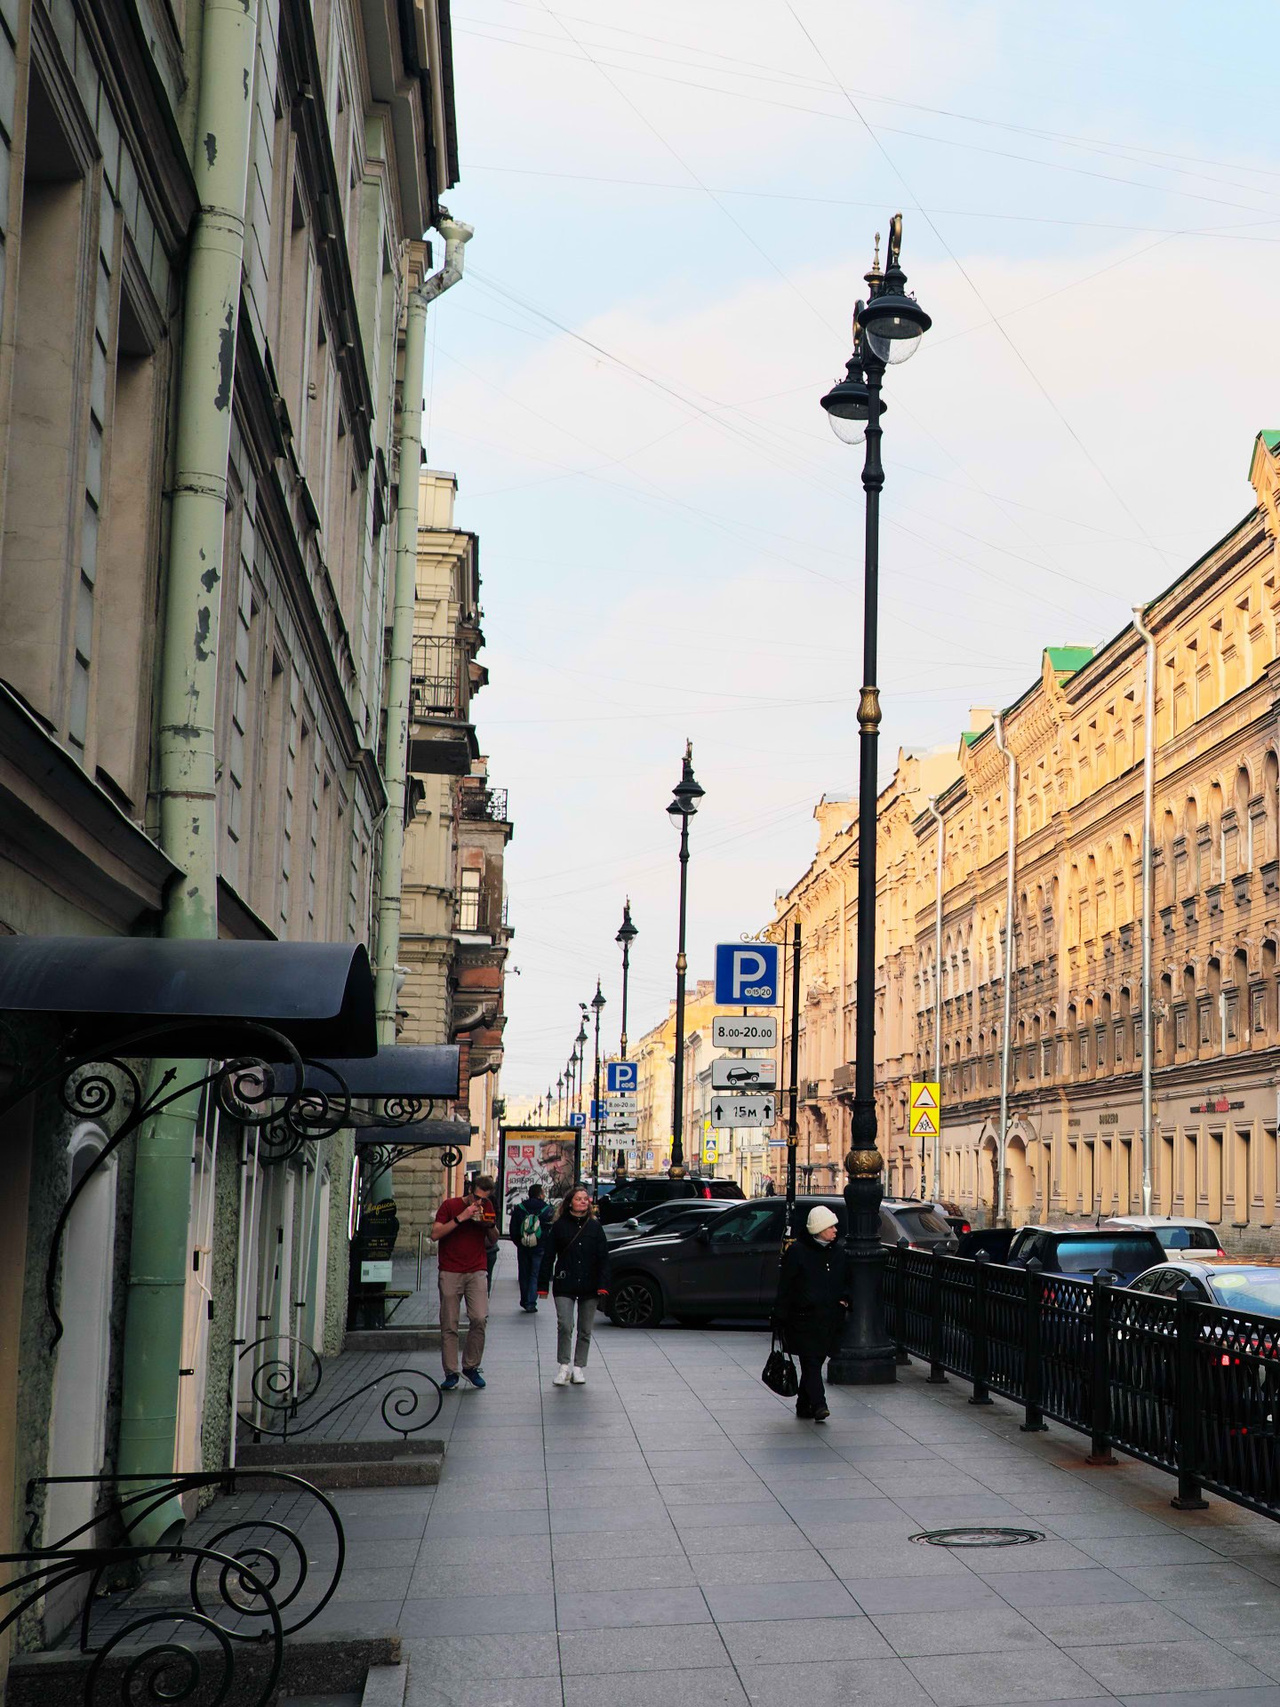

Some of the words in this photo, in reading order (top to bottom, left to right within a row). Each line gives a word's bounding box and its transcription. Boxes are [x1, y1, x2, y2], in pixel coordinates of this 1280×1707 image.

[732, 950, 767, 999] P
[761, 988, 771, 996] 20
[718, 1026, 772, 1038] 8.00-20.00
[615, 1065, 632, 1089] P
[574, 1114, 584, 1127] P
